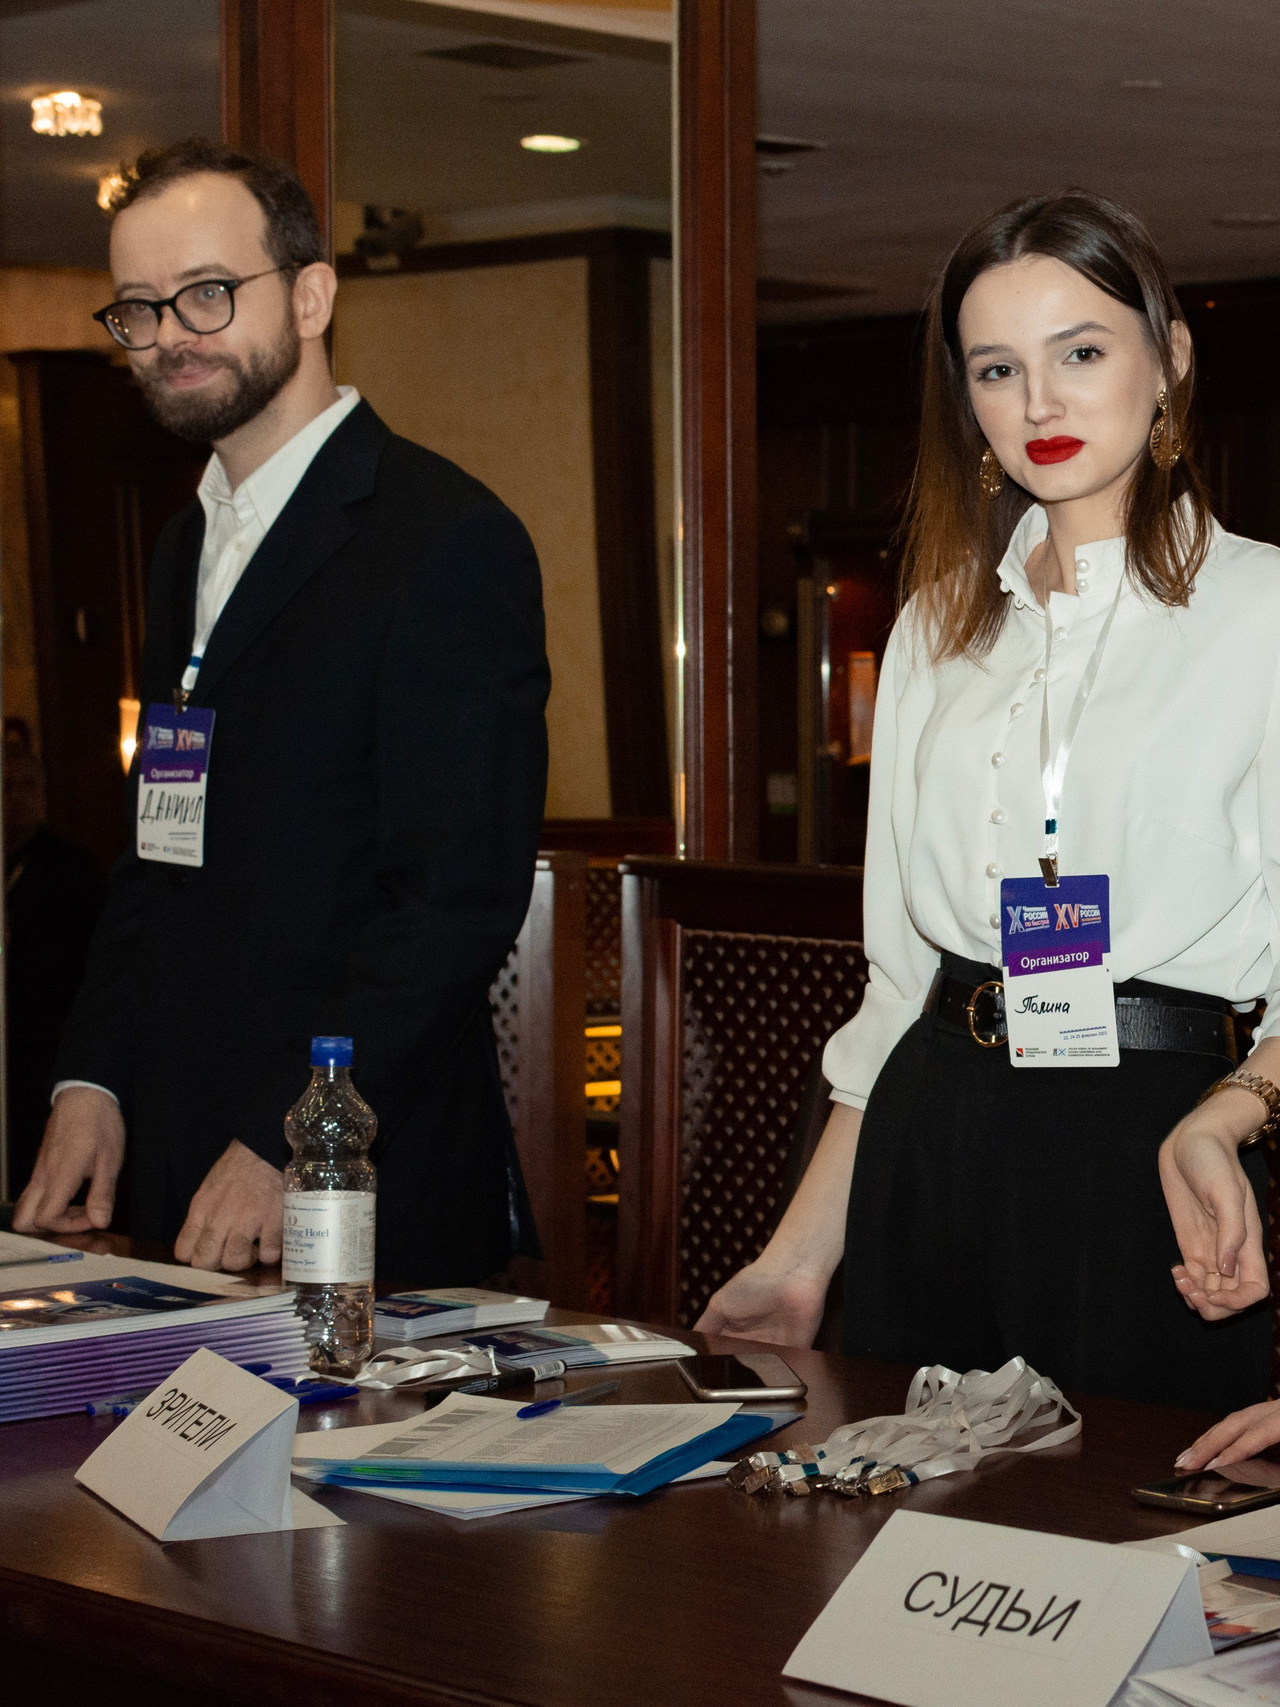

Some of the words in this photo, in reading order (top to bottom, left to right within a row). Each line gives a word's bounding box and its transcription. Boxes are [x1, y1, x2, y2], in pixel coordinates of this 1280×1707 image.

[150, 767, 195, 781] Организатор
[1006, 906, 1025, 935] X
[1023, 911, 1048, 921] РОССИИ
[1053, 903, 1080, 931] XV
[1080, 909, 1101, 918] РОССИИ
[1020, 951, 1090, 970] Организатор
[1014, 994, 1070, 1015] Полина
[305, 1228, 329, 1237] Hotel
[145, 1387, 238, 1452] ЗРИТЕЛИ
[903, 1570, 1081, 1642] СУДЬИ
